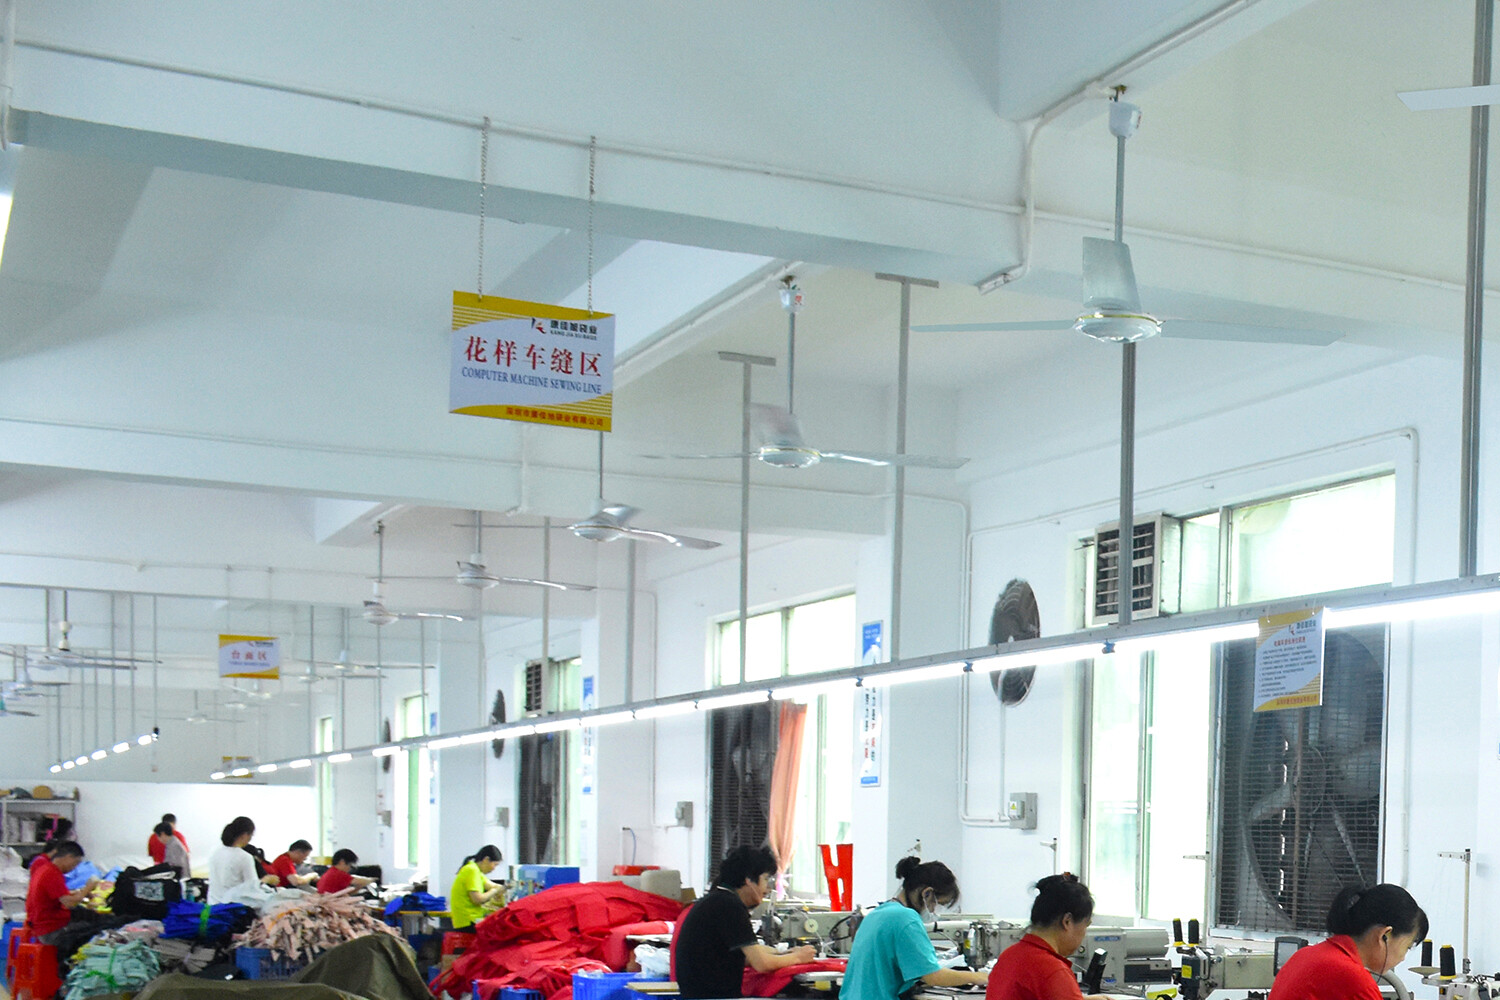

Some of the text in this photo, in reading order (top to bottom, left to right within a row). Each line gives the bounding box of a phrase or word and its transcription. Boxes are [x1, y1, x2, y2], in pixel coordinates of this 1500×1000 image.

[464, 335, 602, 377] 花样车缝区
[462, 366, 602, 395] COMPUTER MACHINE SEWING LINE
